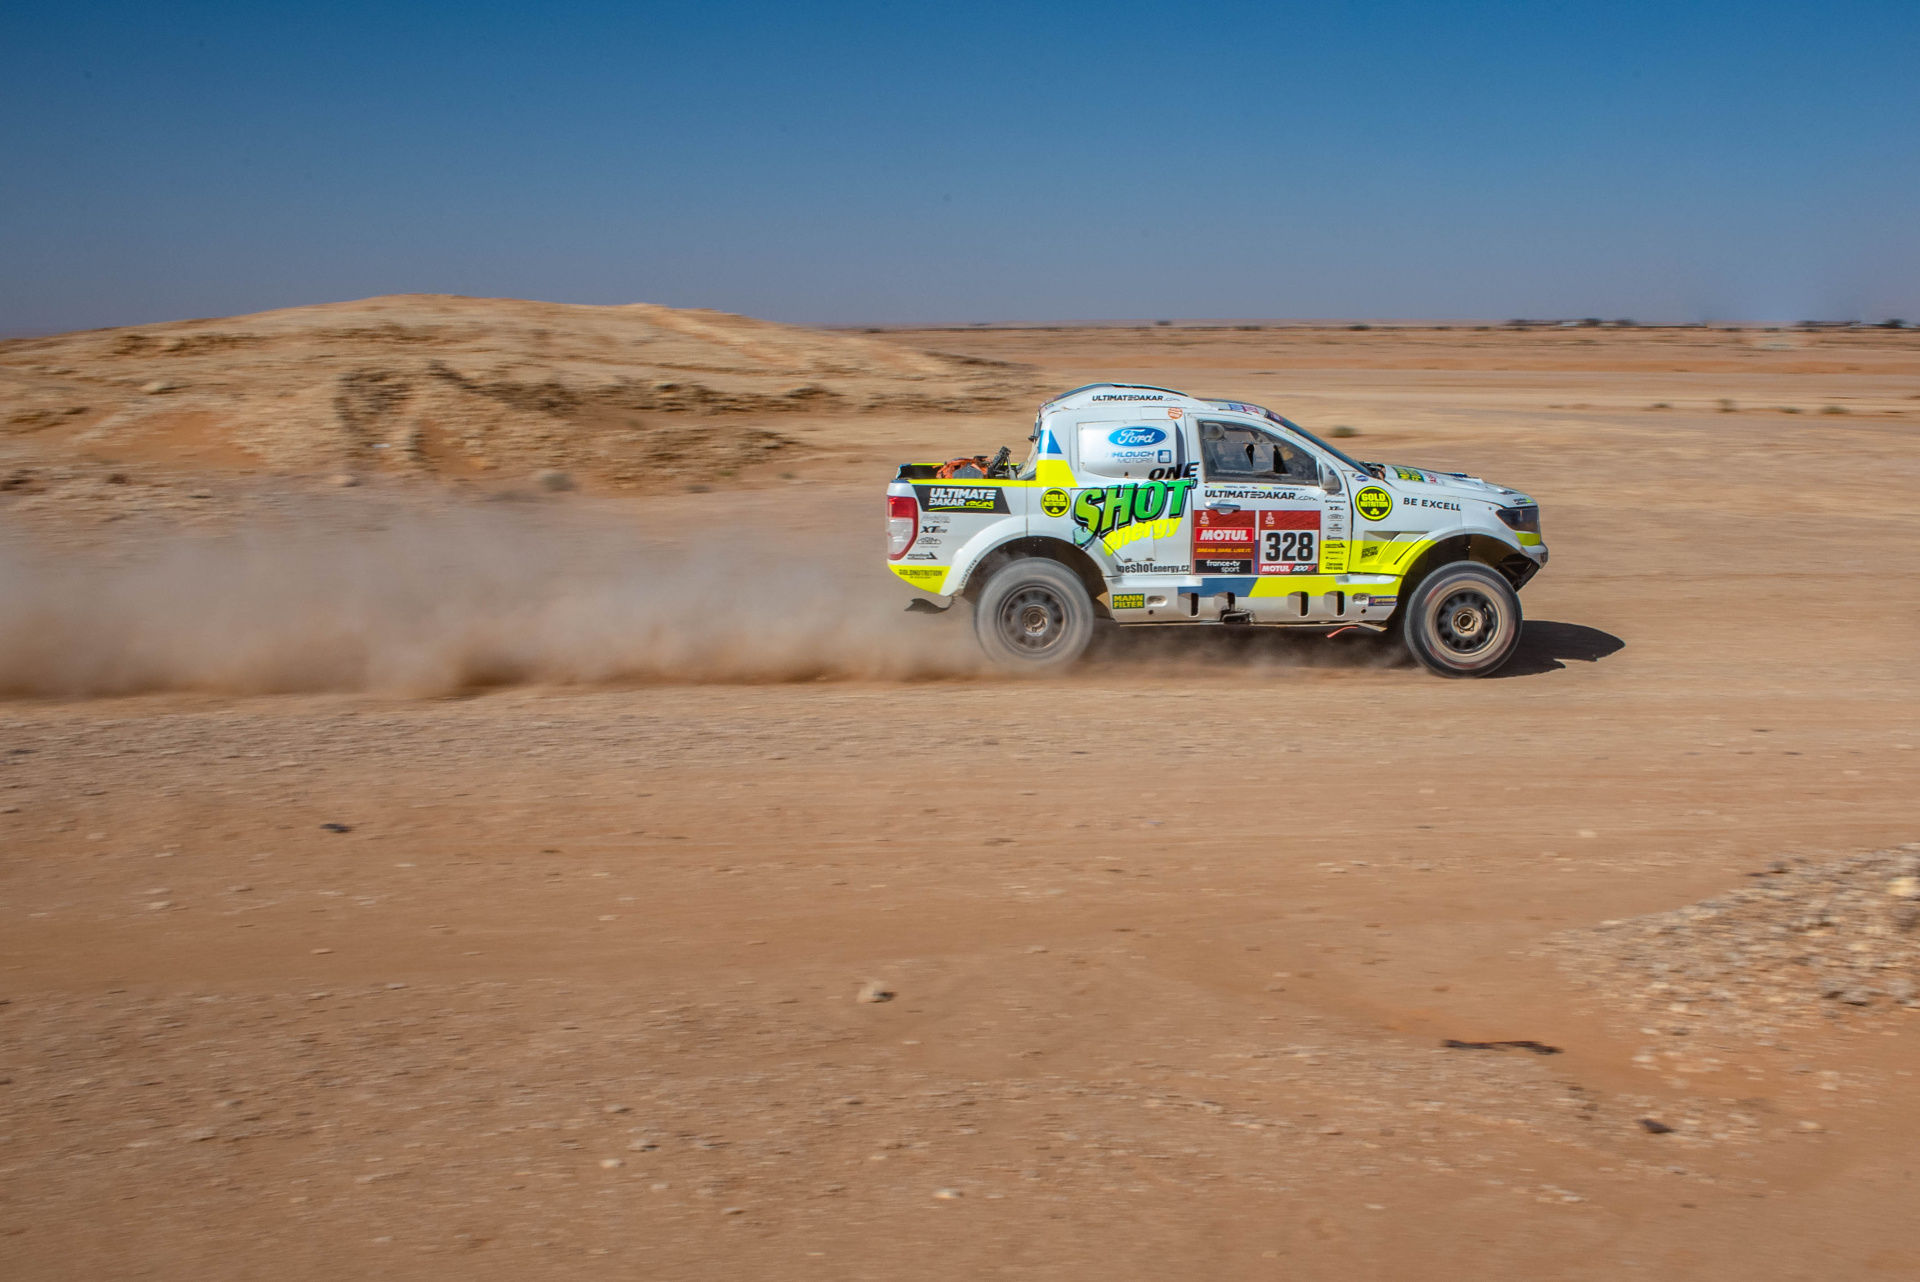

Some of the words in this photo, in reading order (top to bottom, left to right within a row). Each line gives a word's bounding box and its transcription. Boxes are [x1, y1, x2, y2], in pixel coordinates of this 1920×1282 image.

[1117, 428, 1156, 444] Ford
[1148, 462, 1199, 480] ONE
[930, 488, 997, 500] ULTIMATE
[1361, 493, 1386, 501] GOLD
[928, 498, 966, 506] DAKAR
[1403, 497, 1417, 506] BE
[1073, 479, 1198, 551] SHOT
[1103, 517, 1183, 557] energy
[1200, 530, 1249, 541] MOTUL
[1265, 532, 1314, 562] 328
